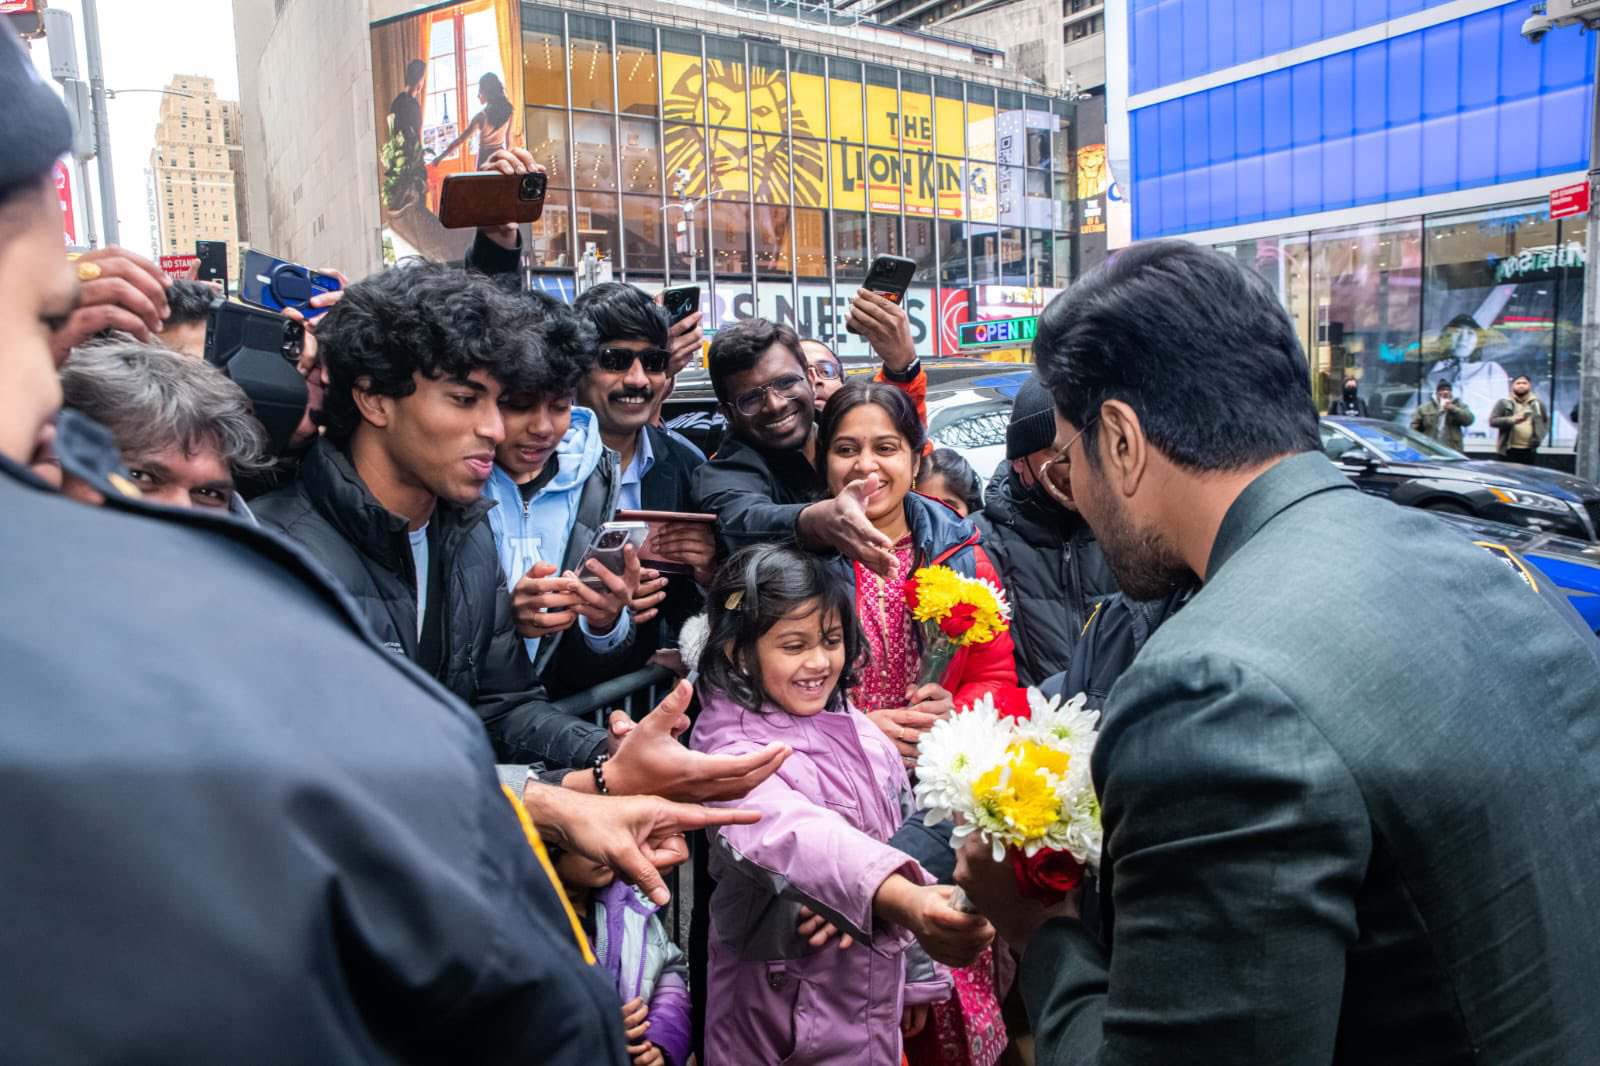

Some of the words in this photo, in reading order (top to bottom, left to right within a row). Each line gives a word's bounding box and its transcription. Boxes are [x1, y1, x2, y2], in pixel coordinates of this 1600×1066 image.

[886, 111, 931, 140] THE
[840, 136, 912, 192] LION
[174, 258, 193, 268] STAN
[776, 295, 927, 345] NES
[976, 319, 1018, 342] OPEN
[1023, 319, 1037, 340] N
